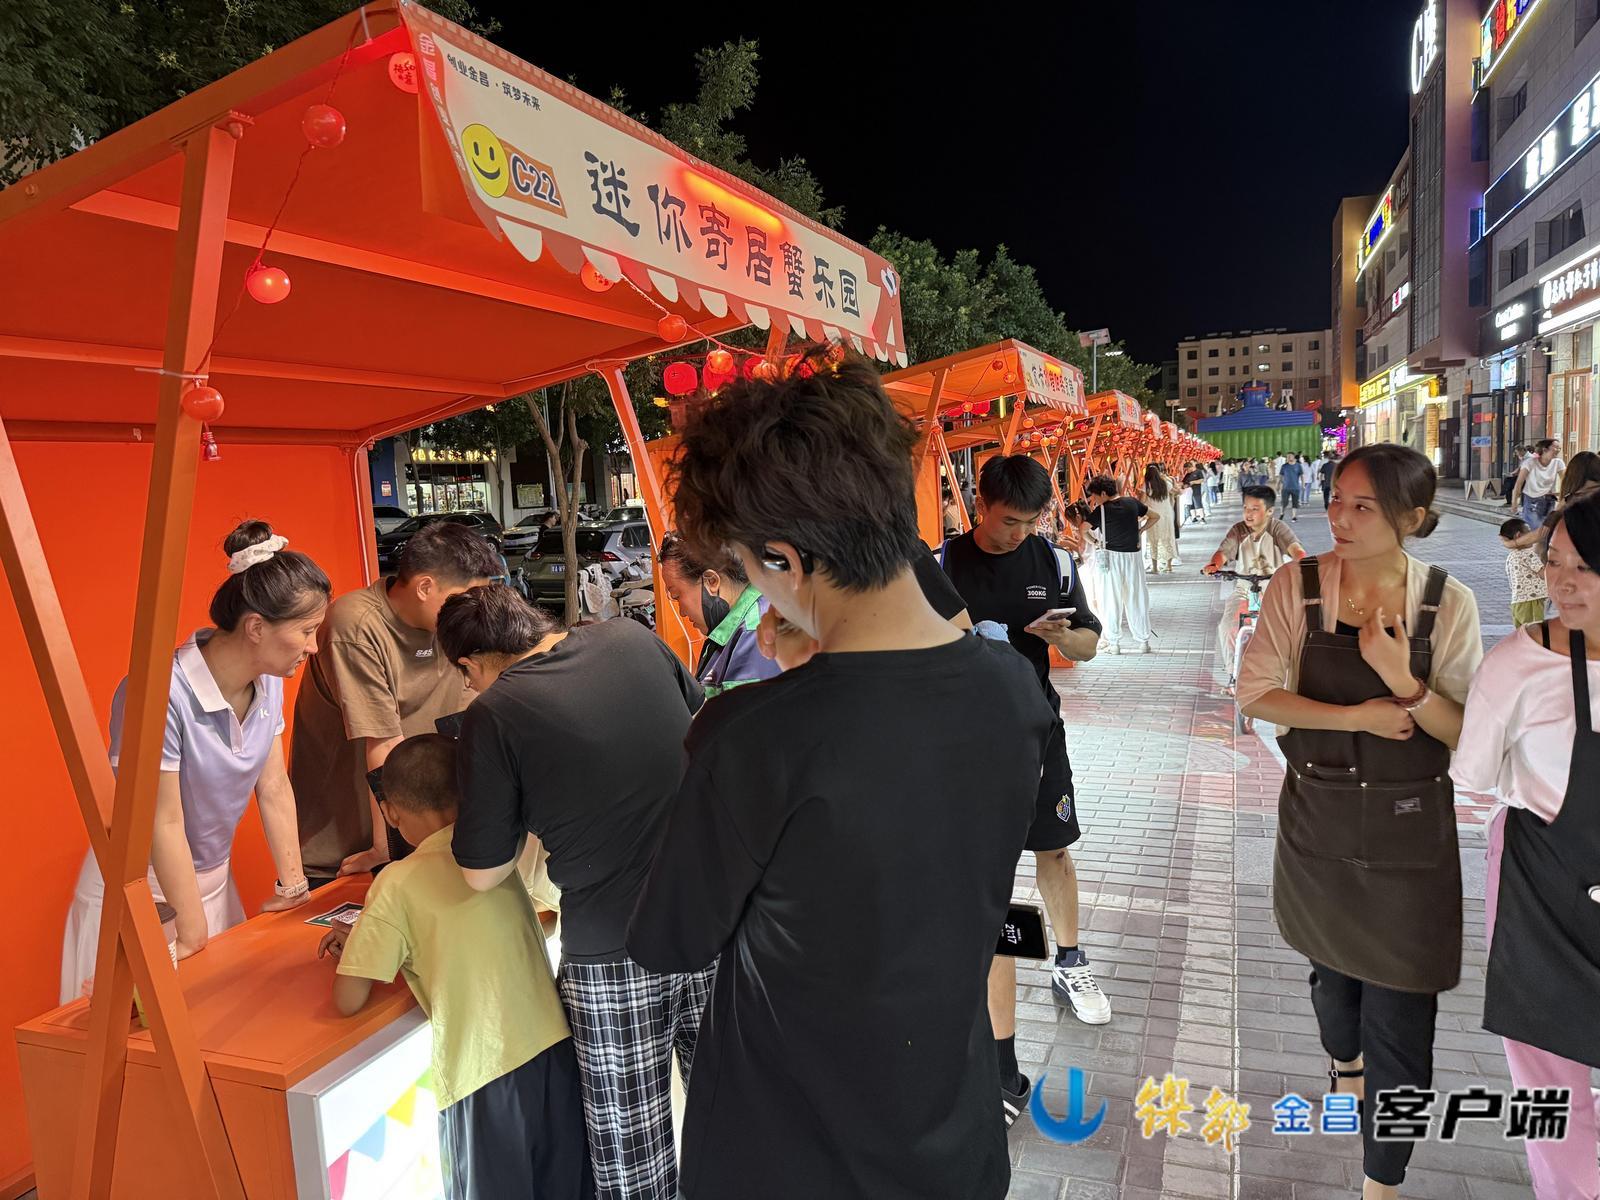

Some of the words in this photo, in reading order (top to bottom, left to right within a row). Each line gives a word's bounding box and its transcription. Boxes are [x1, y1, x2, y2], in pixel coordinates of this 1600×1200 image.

[510, 153, 562, 208] C22
[584, 150, 860, 318] 迷你寄居蟹乐园
[1004, 923, 1018, 945] 21:17
